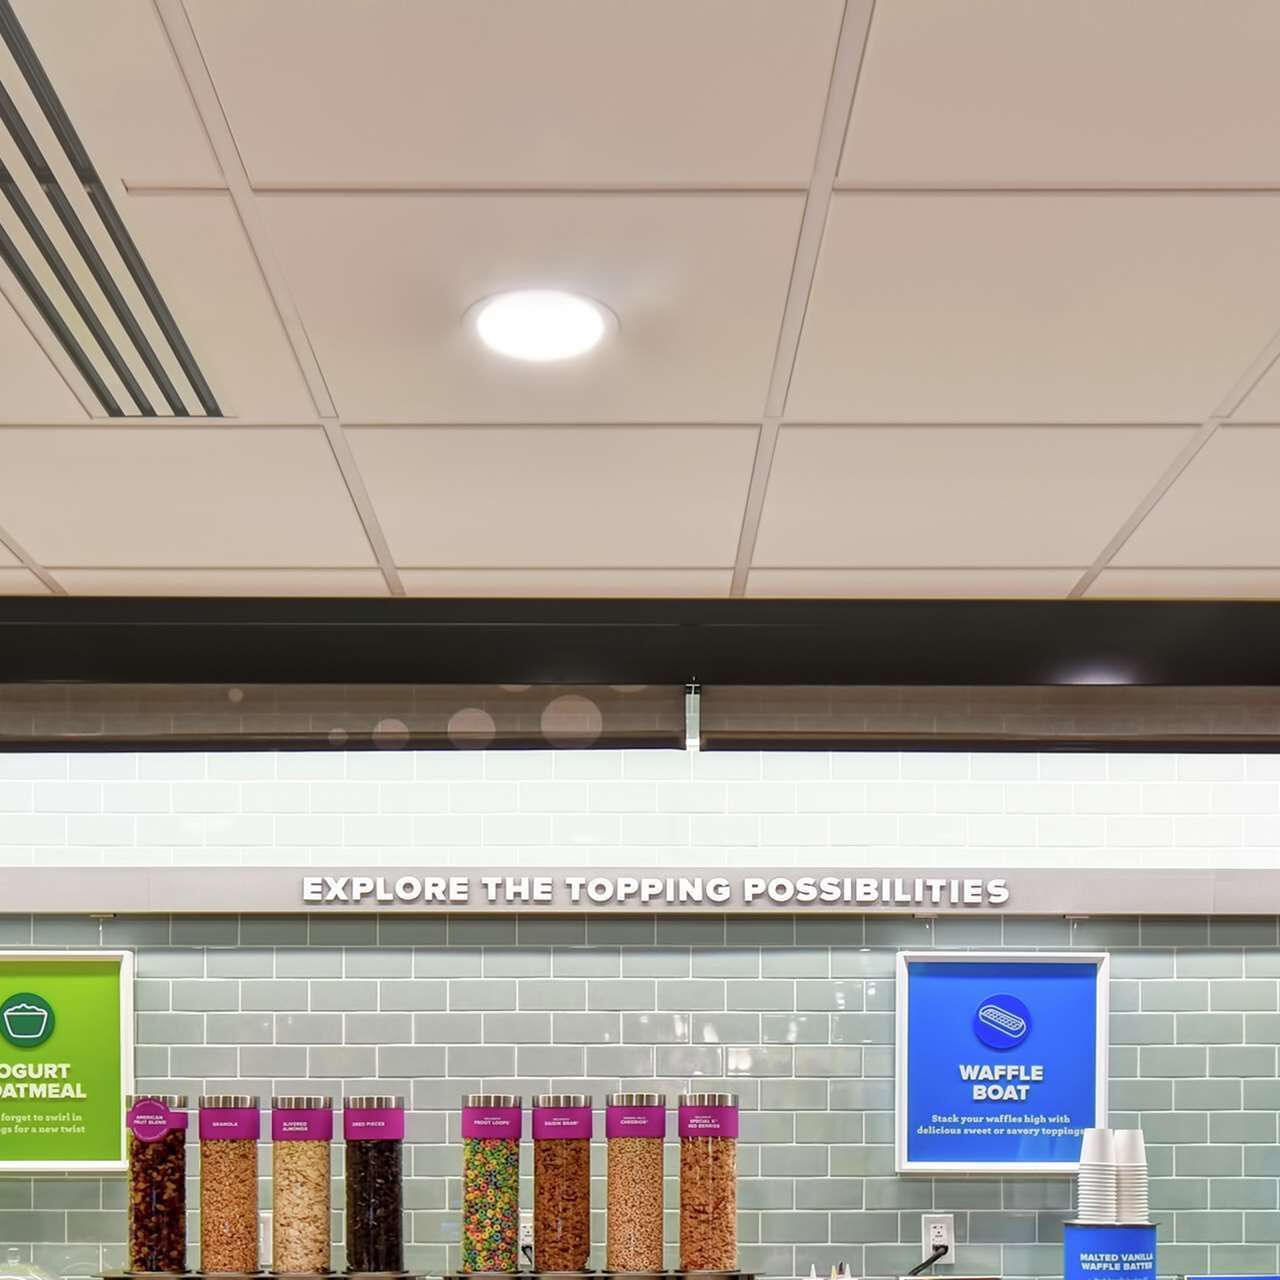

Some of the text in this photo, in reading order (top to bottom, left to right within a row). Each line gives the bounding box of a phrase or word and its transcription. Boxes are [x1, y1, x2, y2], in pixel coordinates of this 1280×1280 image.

[302, 876, 1011, 904] EXPLORE THE TOPPING POSSIBILITIES
[959, 1065, 1044, 1081] WAFFLE
[972, 1085, 1030, 1101] BOAT
[0, 1113, 32, 1124] forget
[33, 1114, 44, 1122] to
[45, 1113, 71, 1122] swirl
[72, 1113, 83, 1122] in
[931, 1114, 1071, 1126] Stack your waffles high with
[13, 1124, 29, 1133] for
[60, 1125, 86, 1133] twist
[916, 1125, 961, 1135] delicious
[963, 1126, 992, 1135] sweet
[994, 1127, 1005, 1135] or
[1006, 1127, 1040, 1137] savory
[1080, 1253, 1119, 1262] MALTED
[1081, 1263, 1121, 1271] WAFFLE
